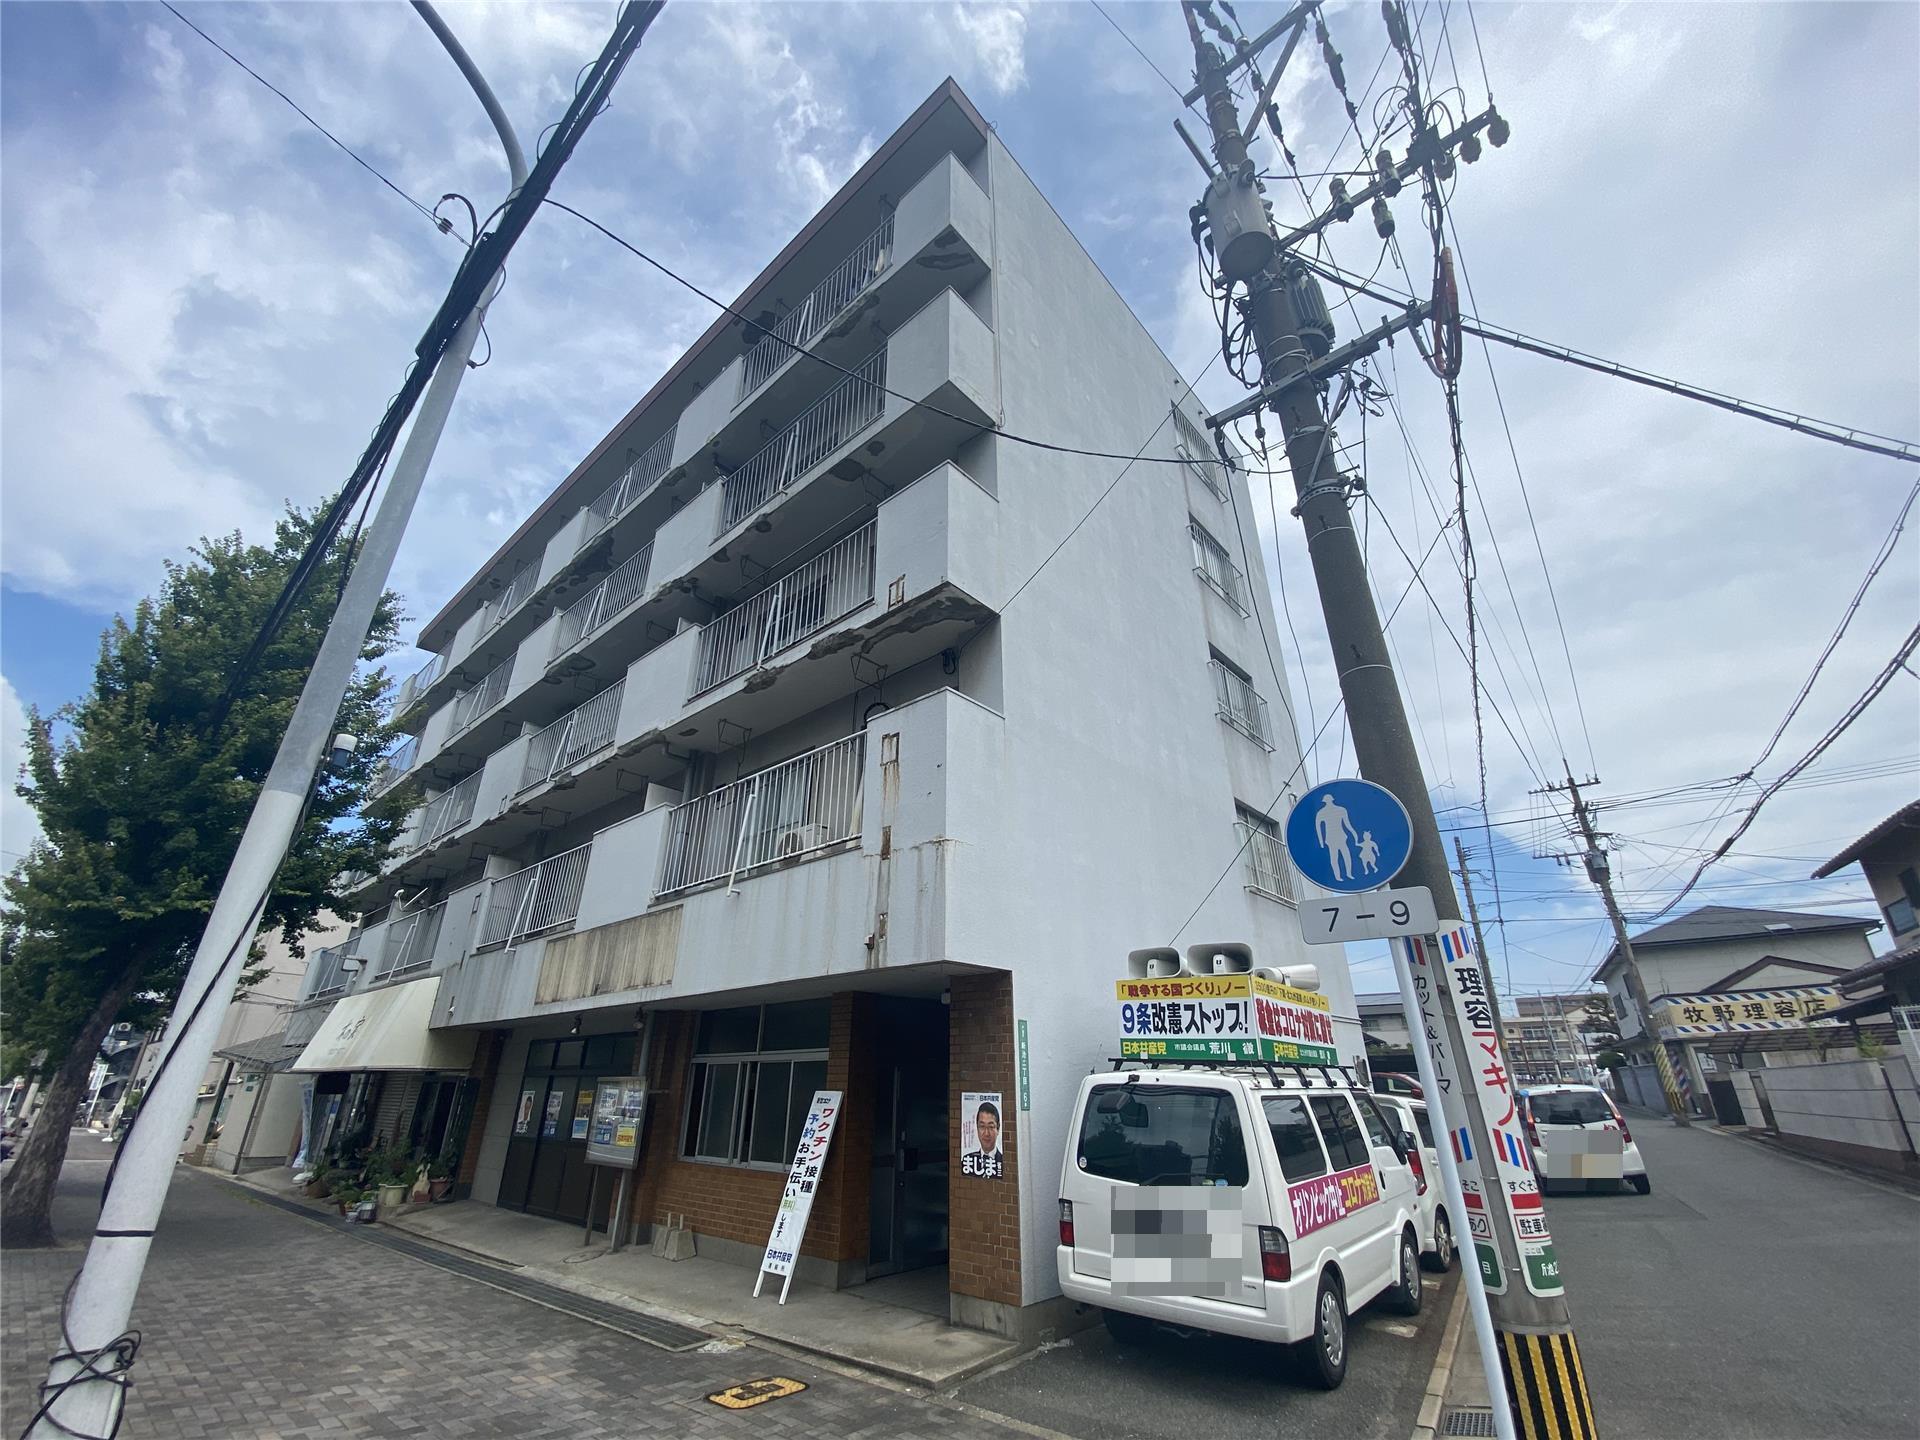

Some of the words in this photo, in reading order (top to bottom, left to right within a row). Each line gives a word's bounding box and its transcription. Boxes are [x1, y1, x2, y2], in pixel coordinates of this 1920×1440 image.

[1683, 1000, 1826, 1022] 牧野理容店
[1122, 1042, 1167, 1055] 日本共産党
[786, 1113, 819, 1197] 予約お手伝い
[800, 1108, 834, 1193] ワクチン接種
